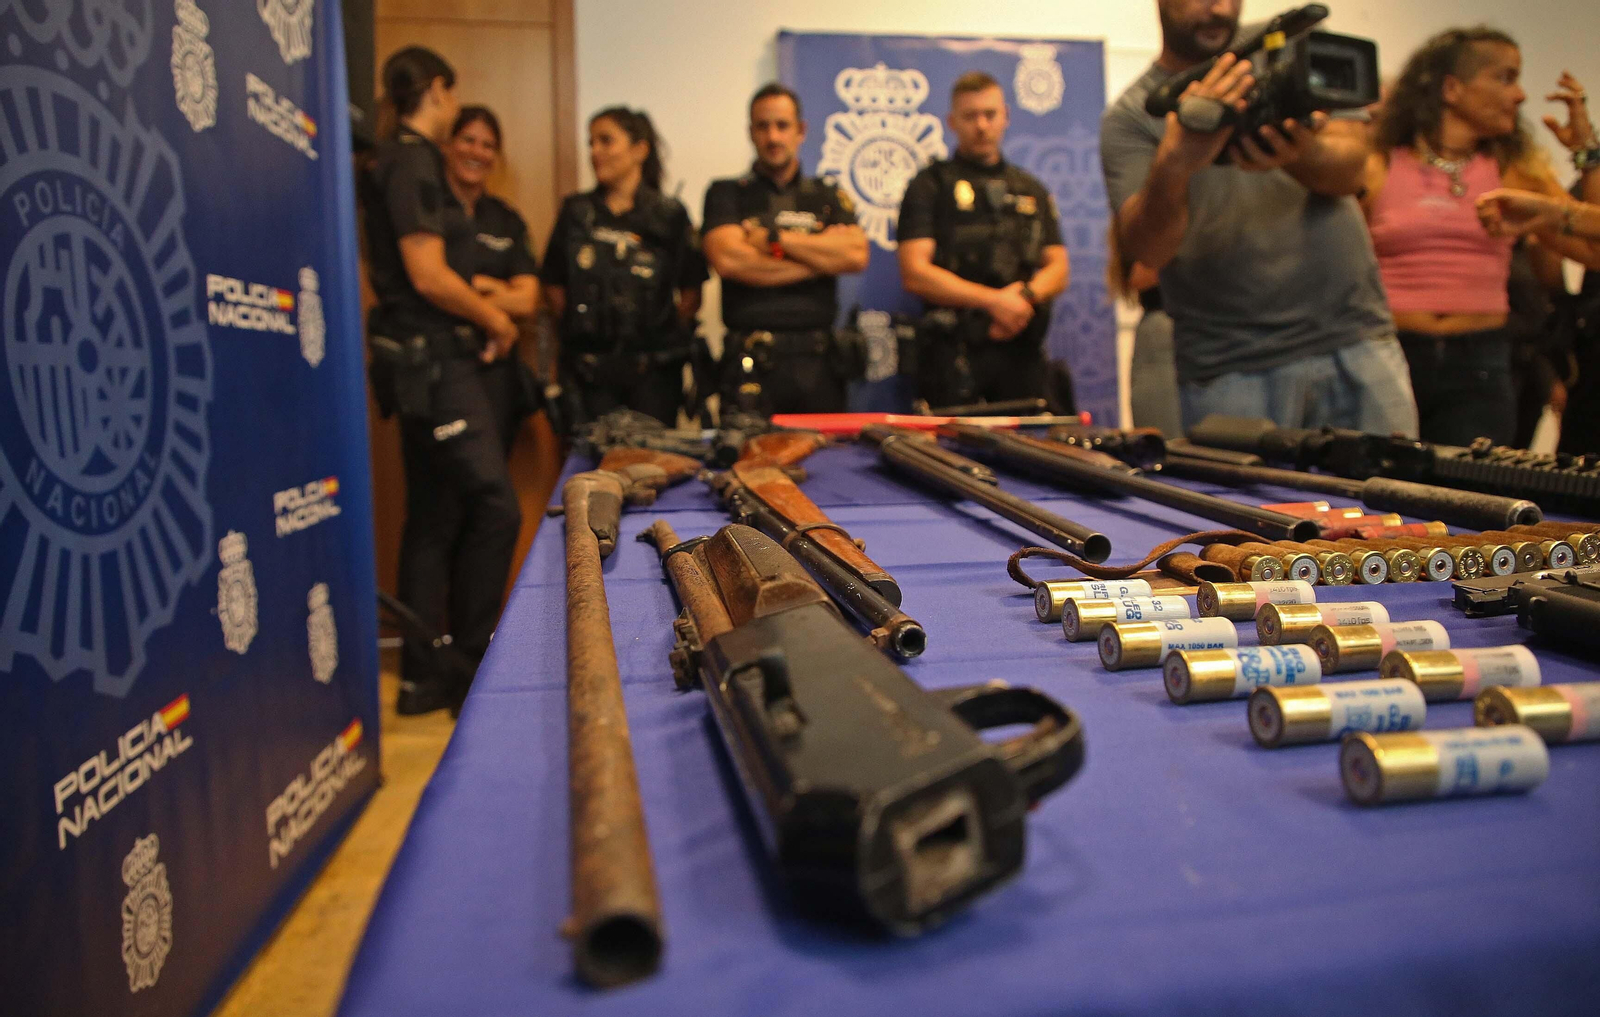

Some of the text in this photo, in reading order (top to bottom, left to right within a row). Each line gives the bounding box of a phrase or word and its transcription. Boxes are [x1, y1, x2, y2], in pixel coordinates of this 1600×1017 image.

[206, 273, 278, 309] POLICIA
[207, 300, 297, 335] NACIONAL
[54, 711, 168, 815] POLICIA
[57, 728, 194, 851] NACIONAL
[265, 734, 349, 837] POLICIA
[268, 750, 367, 870] NACIONAL
